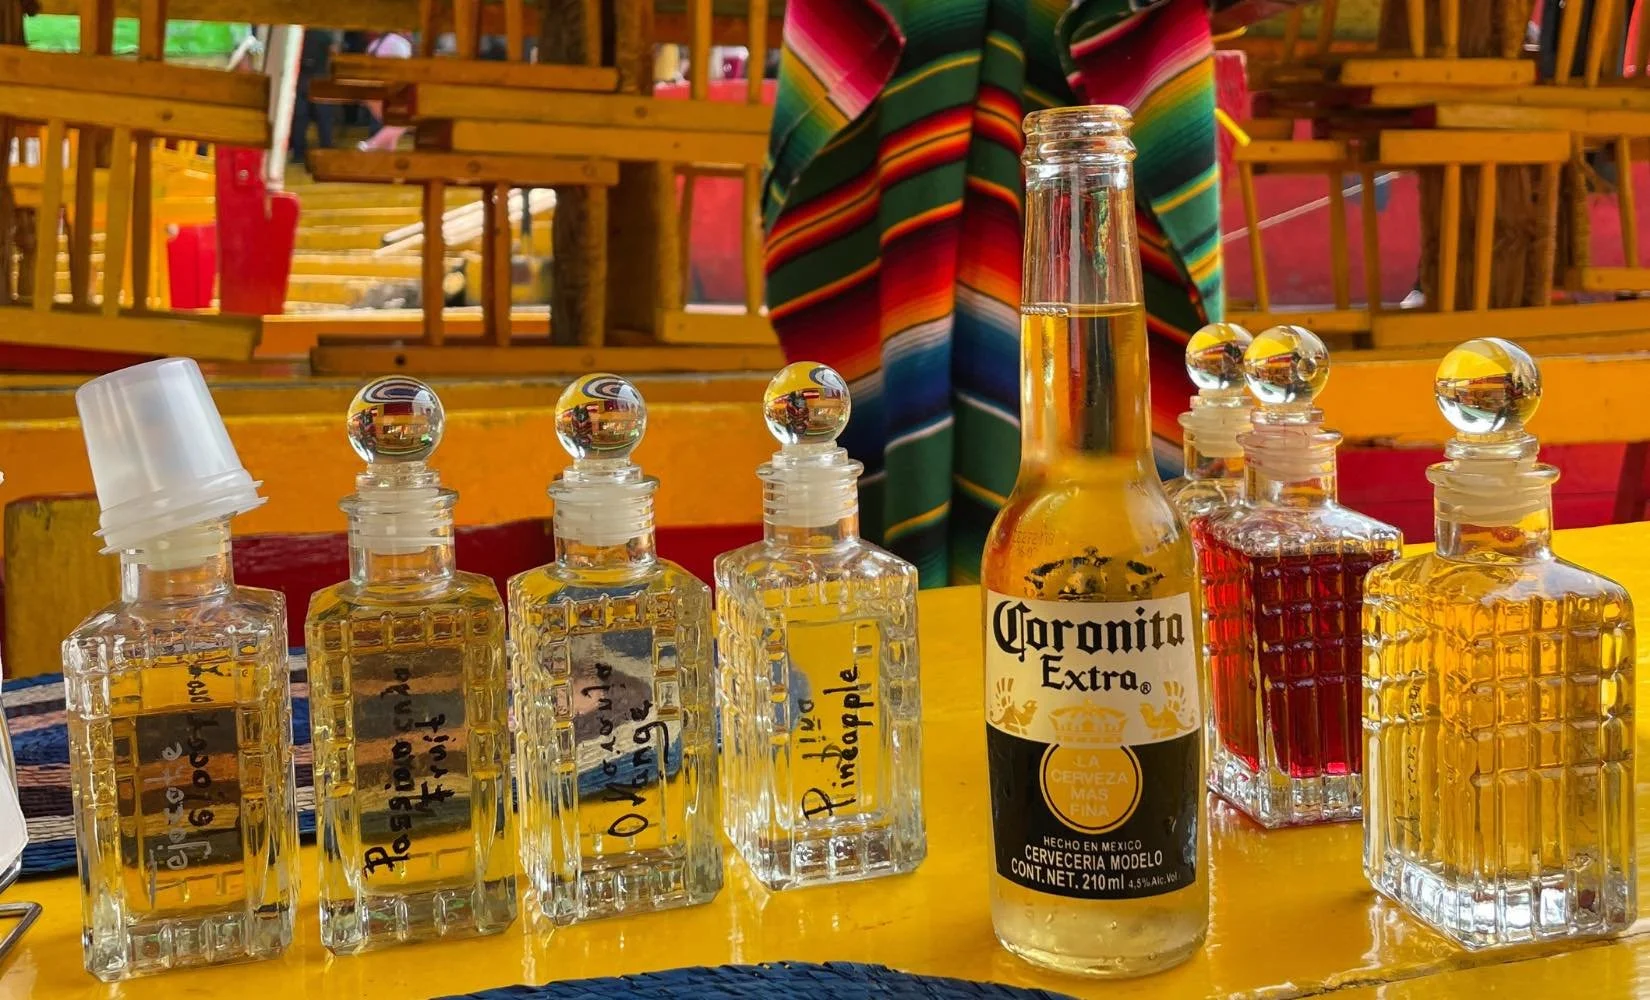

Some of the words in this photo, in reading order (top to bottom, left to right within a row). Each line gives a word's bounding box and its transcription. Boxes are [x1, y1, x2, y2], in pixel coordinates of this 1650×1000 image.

[993, 600, 1185, 662] Coronita
[1040, 654, 1139, 692] Extra
[802, 664, 874, 821] Pineapple
[607, 699, 669, 838] Orange
[1074, 755, 1100, 768] LA
[1051, 769, 1128, 785] CERVEZA
[1071, 786, 1109, 802] MAS
[1070, 803, 1110, 817] FINA
[1043, 835, 1080, 850] HECHO
[1084, 841, 1098, 851] EN
[1102, 839, 1142, 851] MEXICO
[1025, 844, 1105, 870] CERVECERIA
[1110, 850, 1163, 871] MODELO
